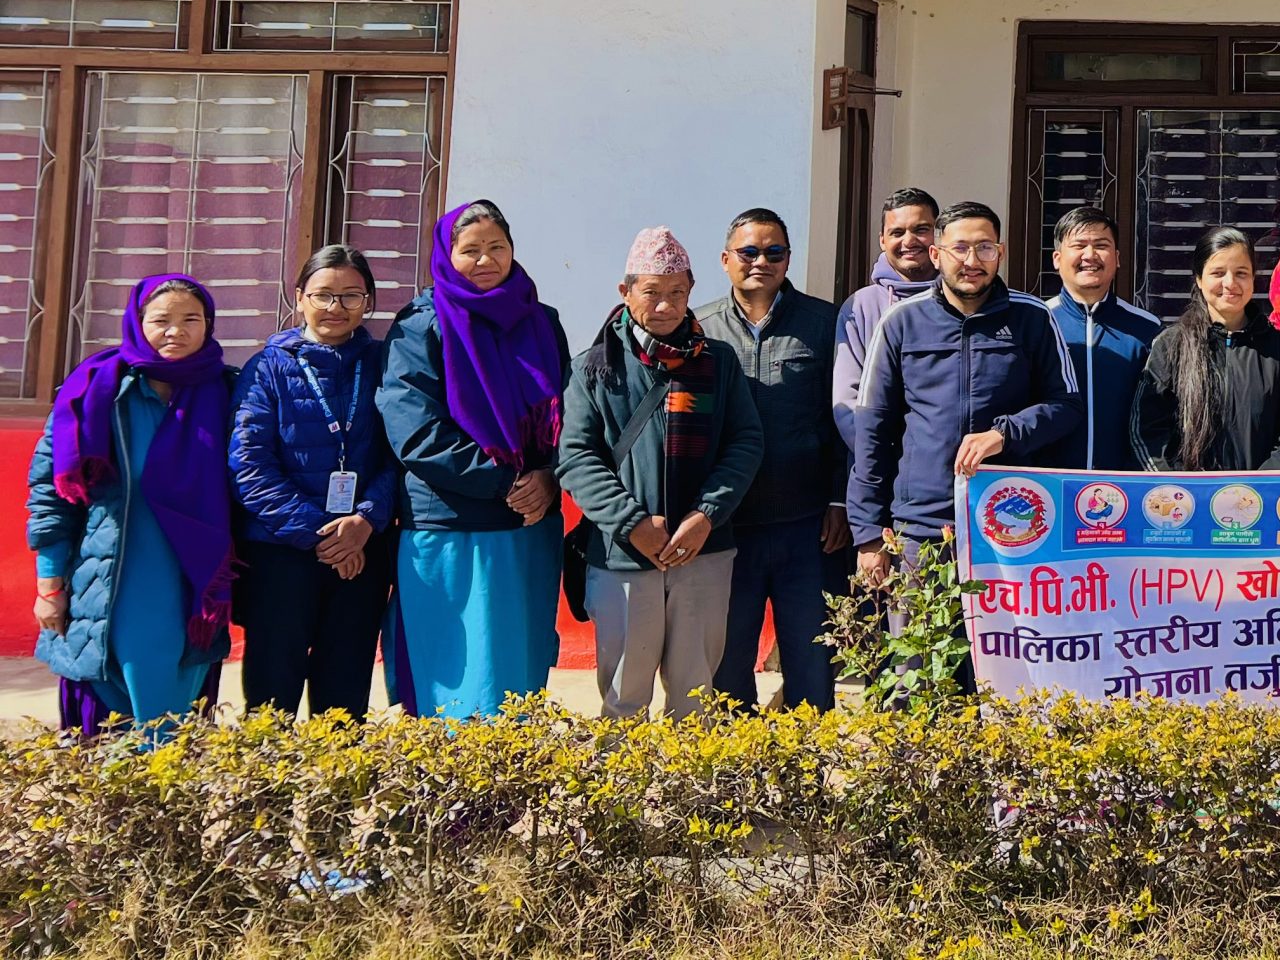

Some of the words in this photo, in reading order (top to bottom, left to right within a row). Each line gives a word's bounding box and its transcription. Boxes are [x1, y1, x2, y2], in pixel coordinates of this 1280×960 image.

[1129, 568, 1224, 619] (HPV)
[978, 626, 1102, 663] पालिका
[1114, 615, 1221, 659] स्तरीय
[1104, 666, 1213, 699] योजना
